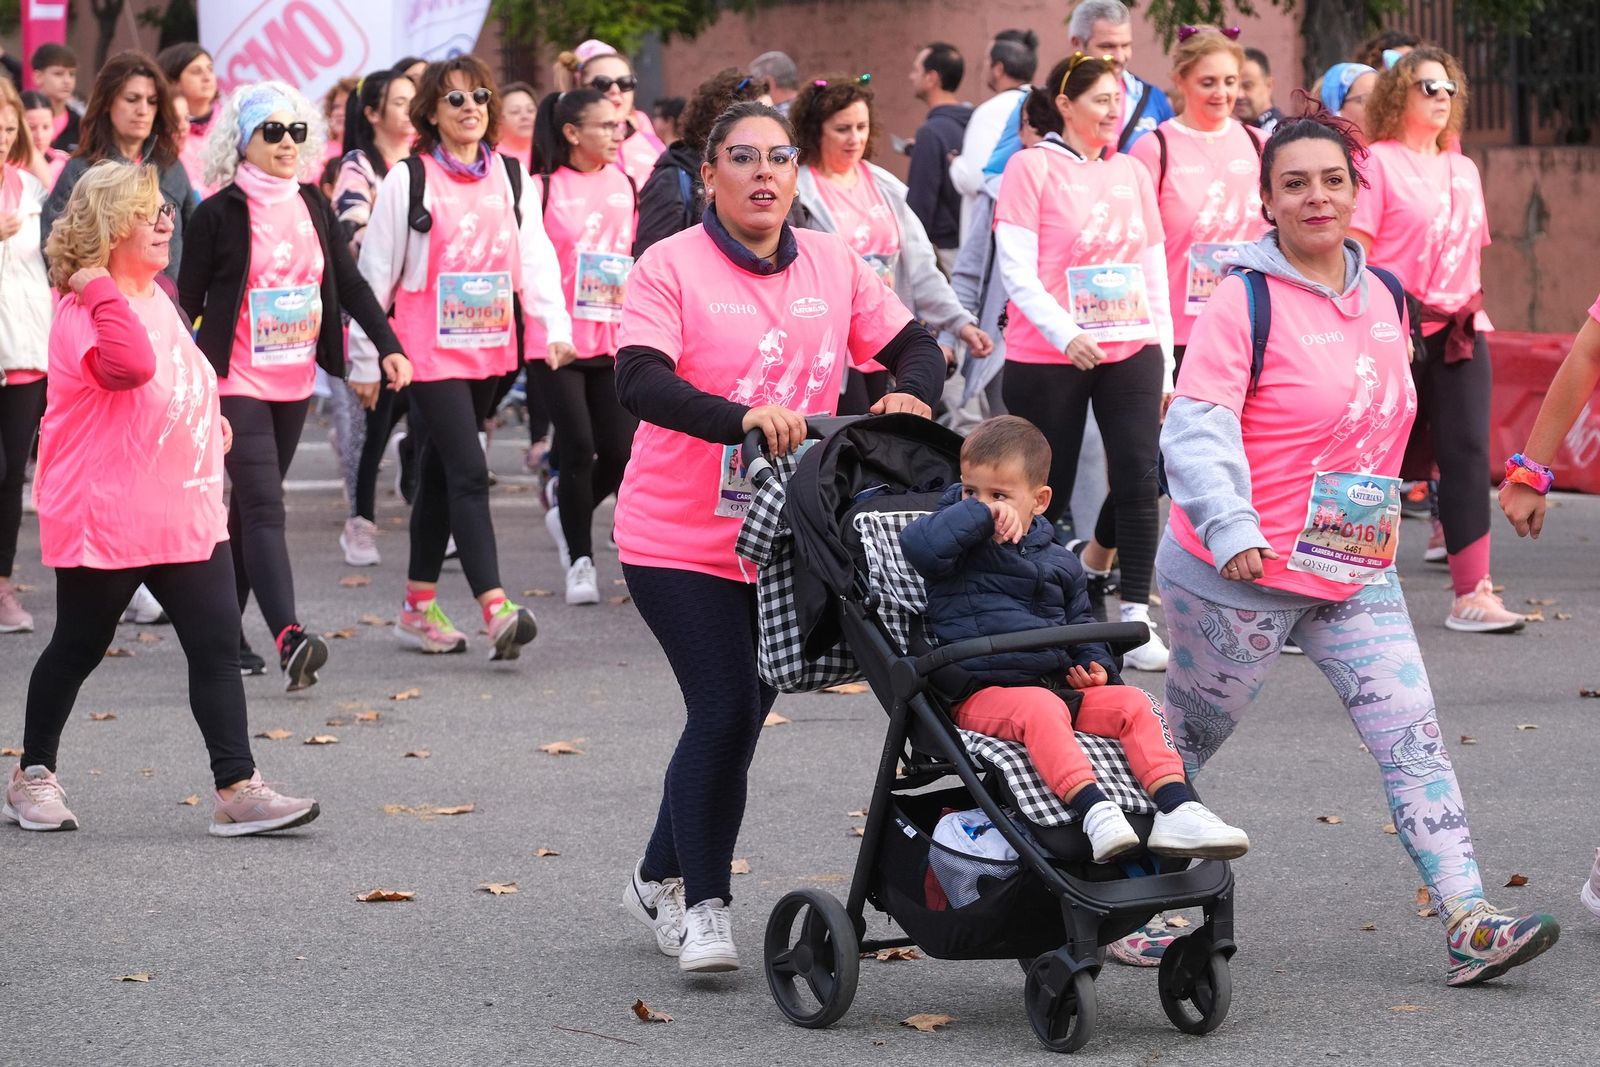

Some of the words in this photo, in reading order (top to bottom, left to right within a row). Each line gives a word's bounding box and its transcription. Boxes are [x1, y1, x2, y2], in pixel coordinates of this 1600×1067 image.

[465, 306, 492, 319] 016
[709, 302, 757, 315] OYSHO
[280, 320, 308, 334] 016
[1341, 522, 1376, 543] 016
[1311, 546, 1334, 557] CARRERA
[1344, 544, 1362, 554] 4461
[1302, 558, 1338, 574] OYSHO
